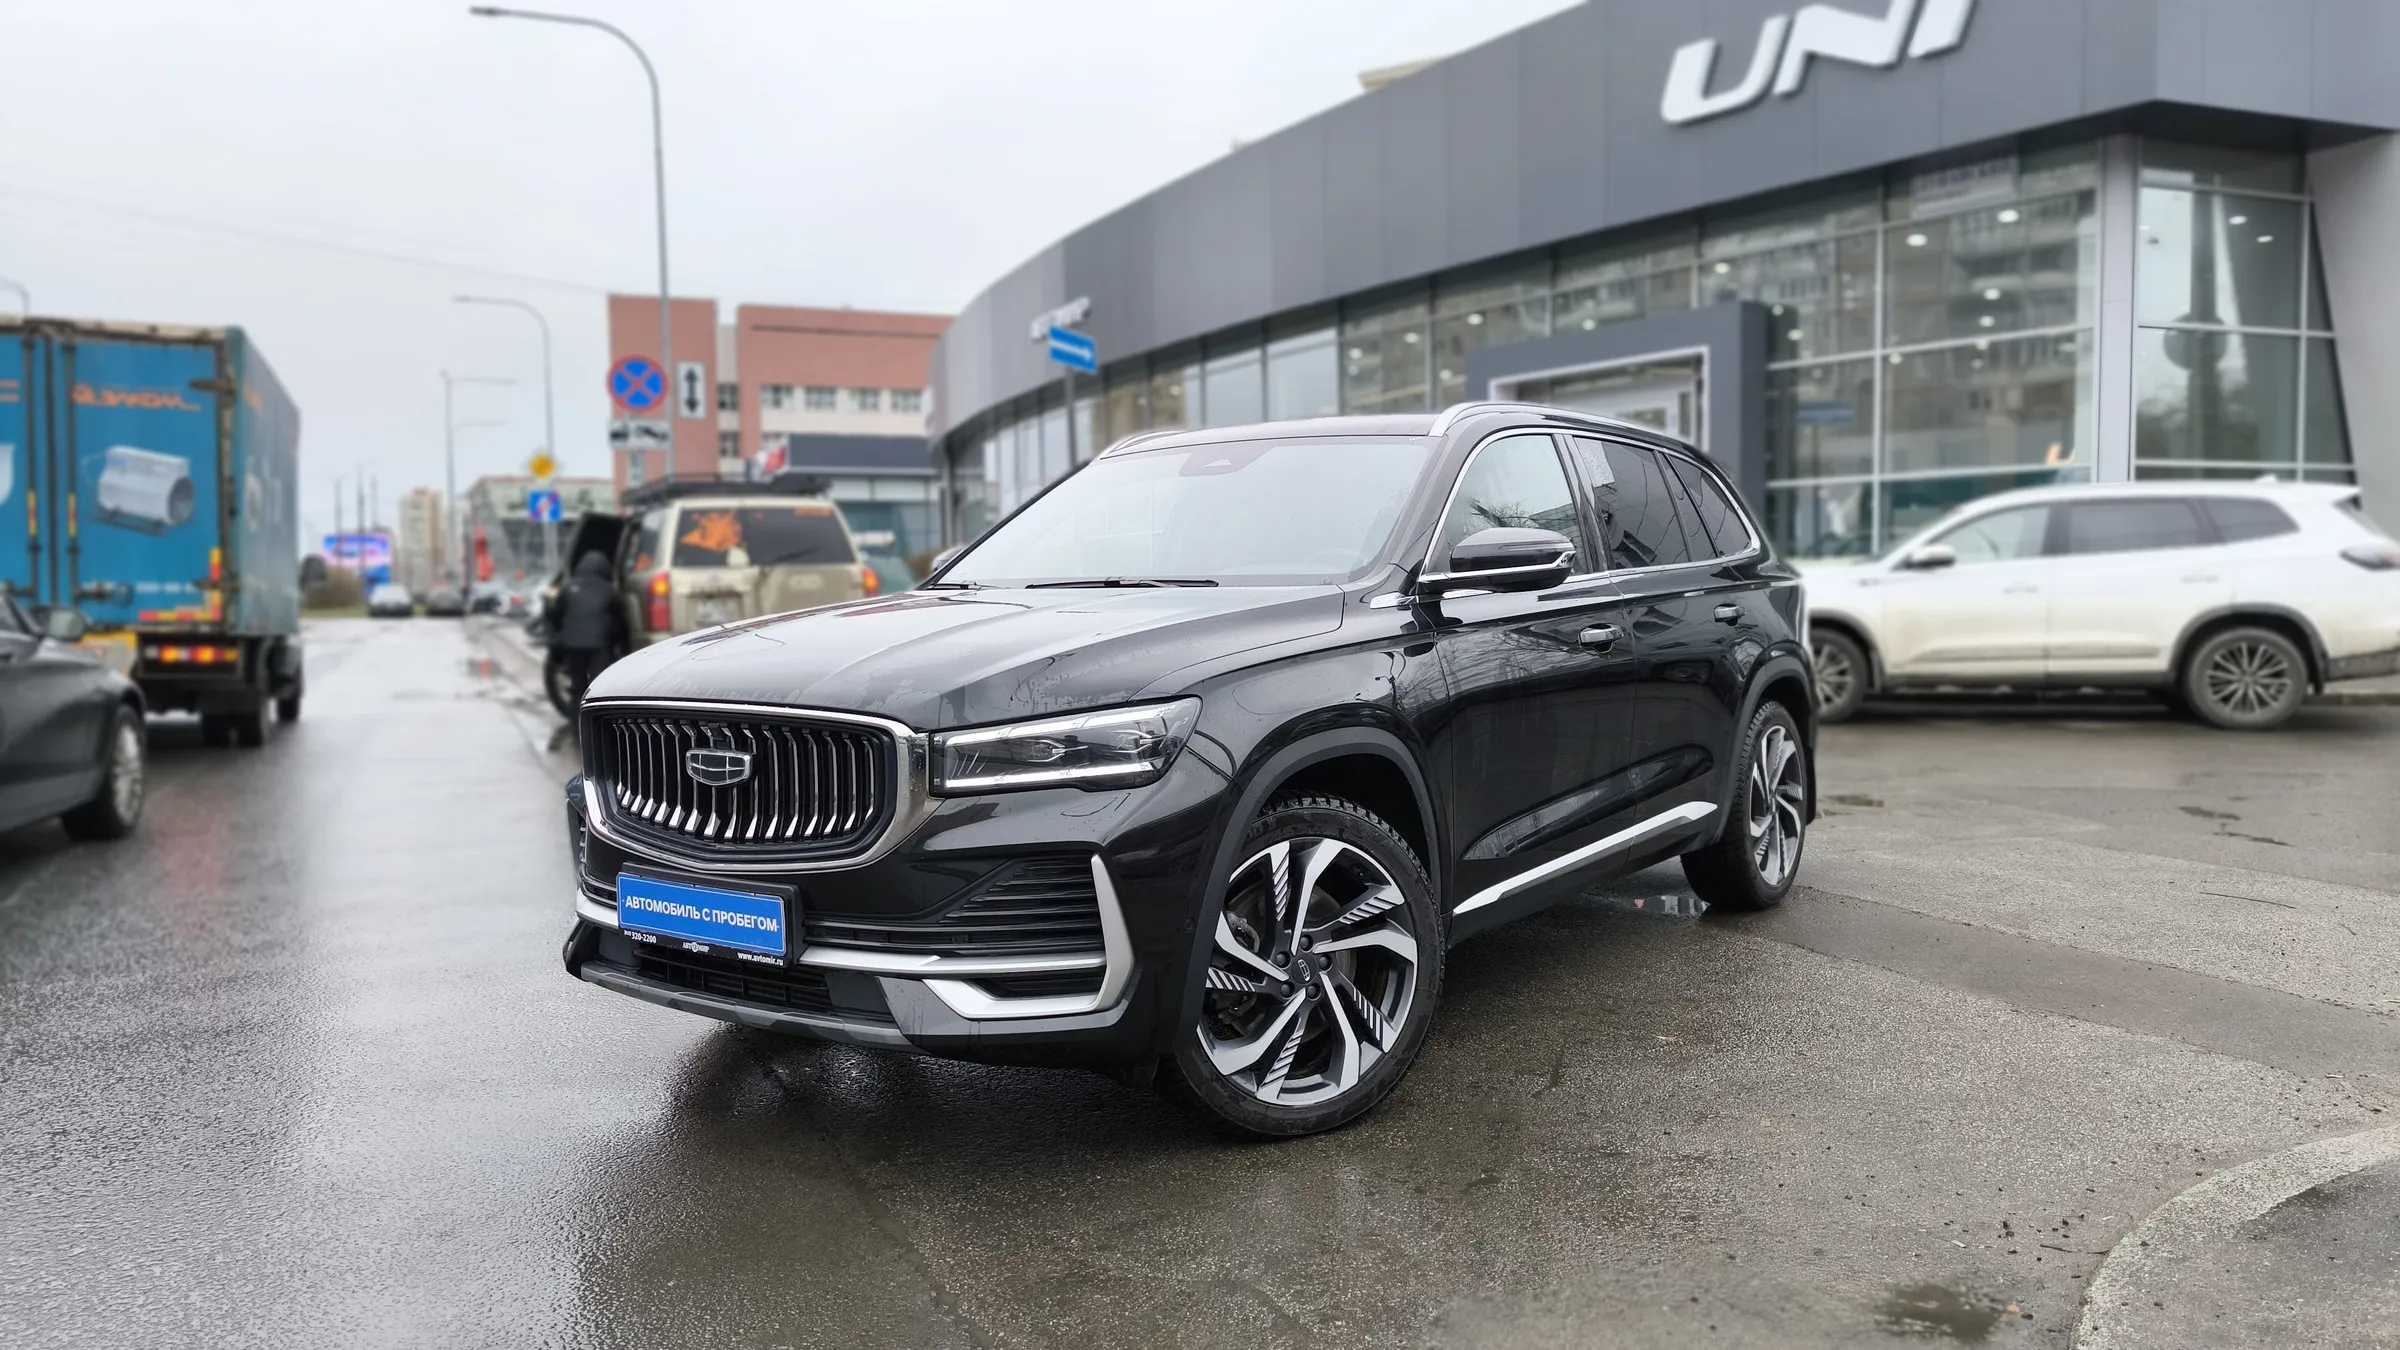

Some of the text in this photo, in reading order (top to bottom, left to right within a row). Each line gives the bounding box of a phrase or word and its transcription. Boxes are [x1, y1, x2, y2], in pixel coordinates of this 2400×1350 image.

[625, 895, 778, 933] АВТОМОБИЛЬ С ПРОБЕГОМ
[631, 931, 657, 944] 320-2200
[737, 952, 784, 966] www.avtomir.ru
